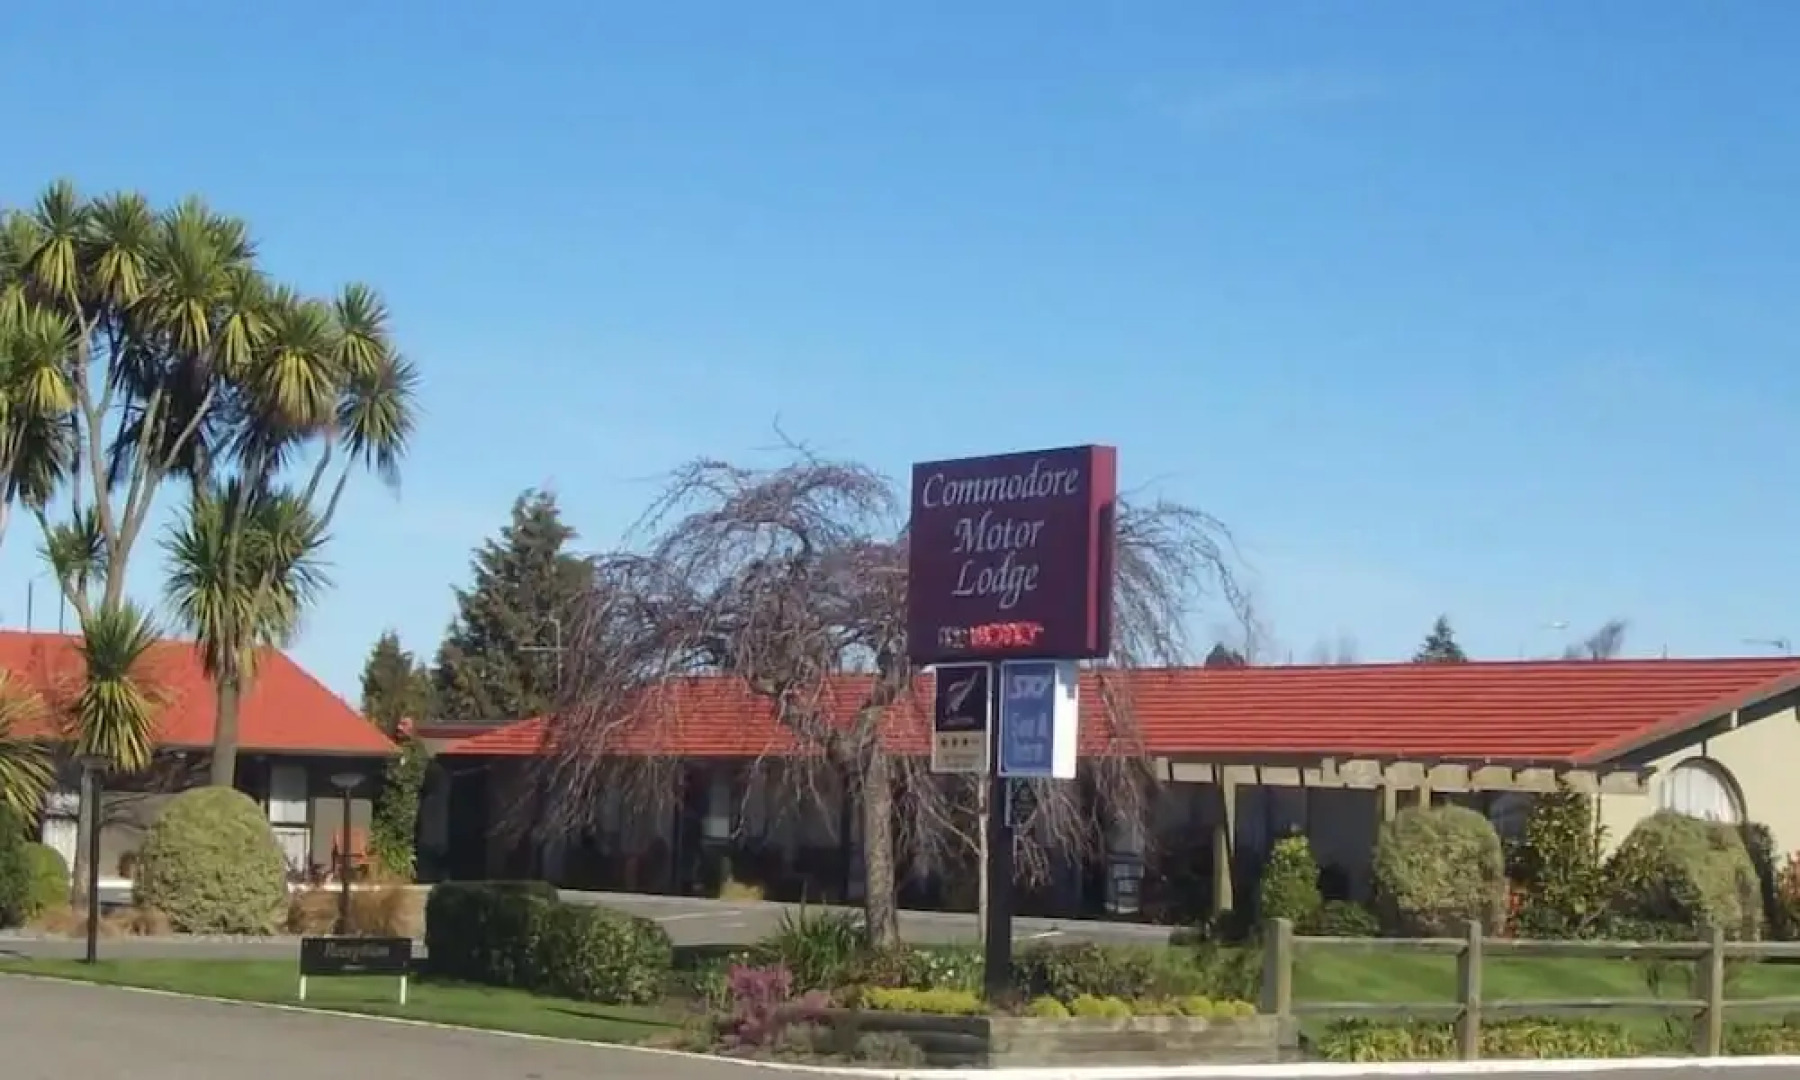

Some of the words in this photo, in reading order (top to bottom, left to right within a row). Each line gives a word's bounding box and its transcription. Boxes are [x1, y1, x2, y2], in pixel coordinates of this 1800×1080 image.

[922, 459, 1079, 508] Commodore
[953, 509, 1045, 554] Motor
[951, 550, 1040, 609] Lodge
